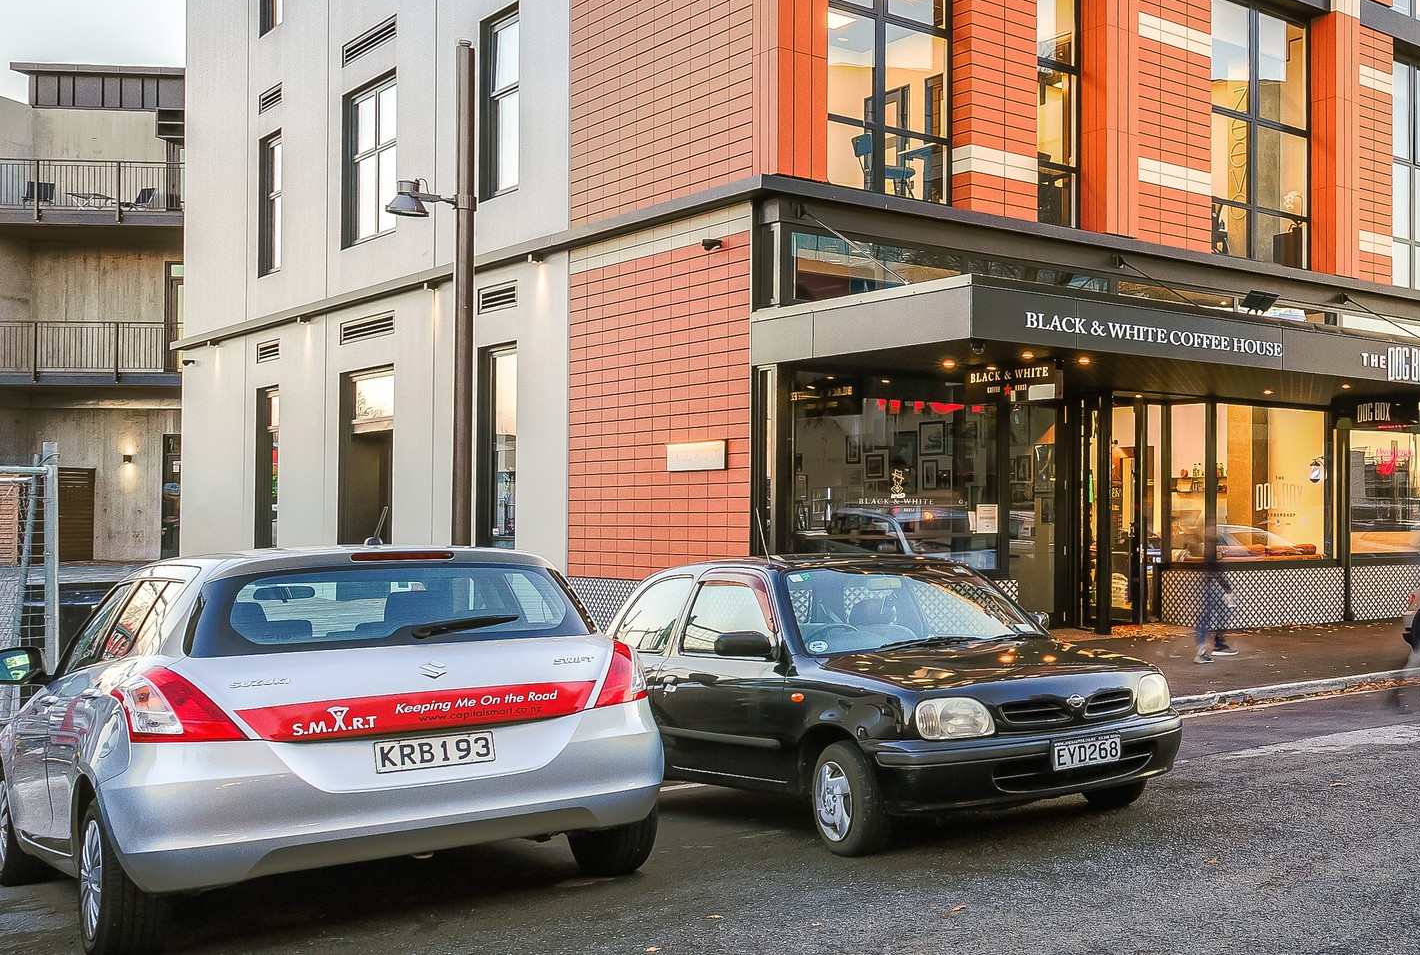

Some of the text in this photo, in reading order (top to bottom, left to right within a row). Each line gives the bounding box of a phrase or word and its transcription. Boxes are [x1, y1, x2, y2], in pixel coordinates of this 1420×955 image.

[1025, 312, 1283, 357] BLACK & WHITE COFFEE HOUSE
[970, 366, 1049, 383] BLACK & WHITE
[1361, 352, 1387, 369] THE
[1387, 347, 1410, 381] DOG
[1357, 402, 1390, 423] DOG BOX
[553, 656, 594, 666] SWIFT
[229, 677, 290, 689] SUZUKI
[395, 689, 558, 714] Keeping Me On the Road
[418, 705, 542, 722] www.capitalsmart.co.nz
[379, 736, 491, 769] KRB193
[1057, 740, 1118, 766] EYD268
